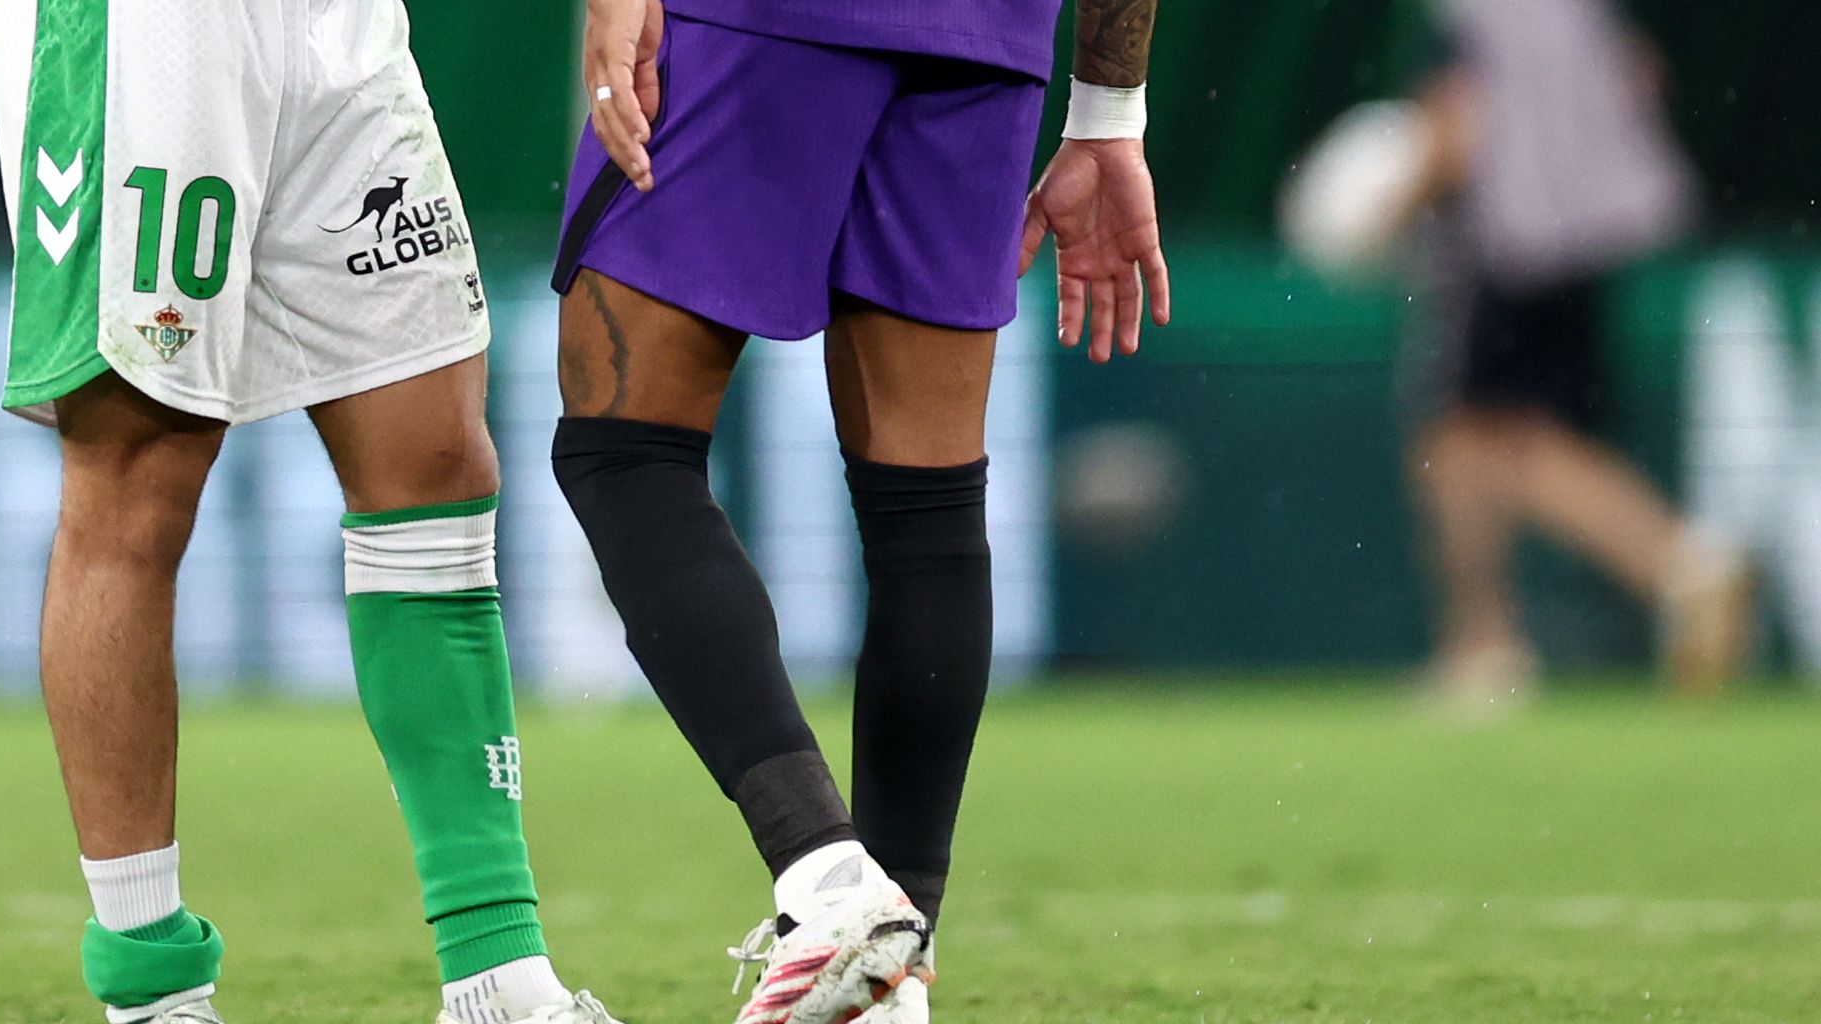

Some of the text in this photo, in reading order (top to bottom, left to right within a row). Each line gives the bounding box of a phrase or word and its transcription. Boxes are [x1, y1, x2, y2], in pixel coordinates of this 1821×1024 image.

[123, 165, 236, 300] 10
[391, 196, 453, 239] AUS
[346, 222, 470, 276] GLOBAL
